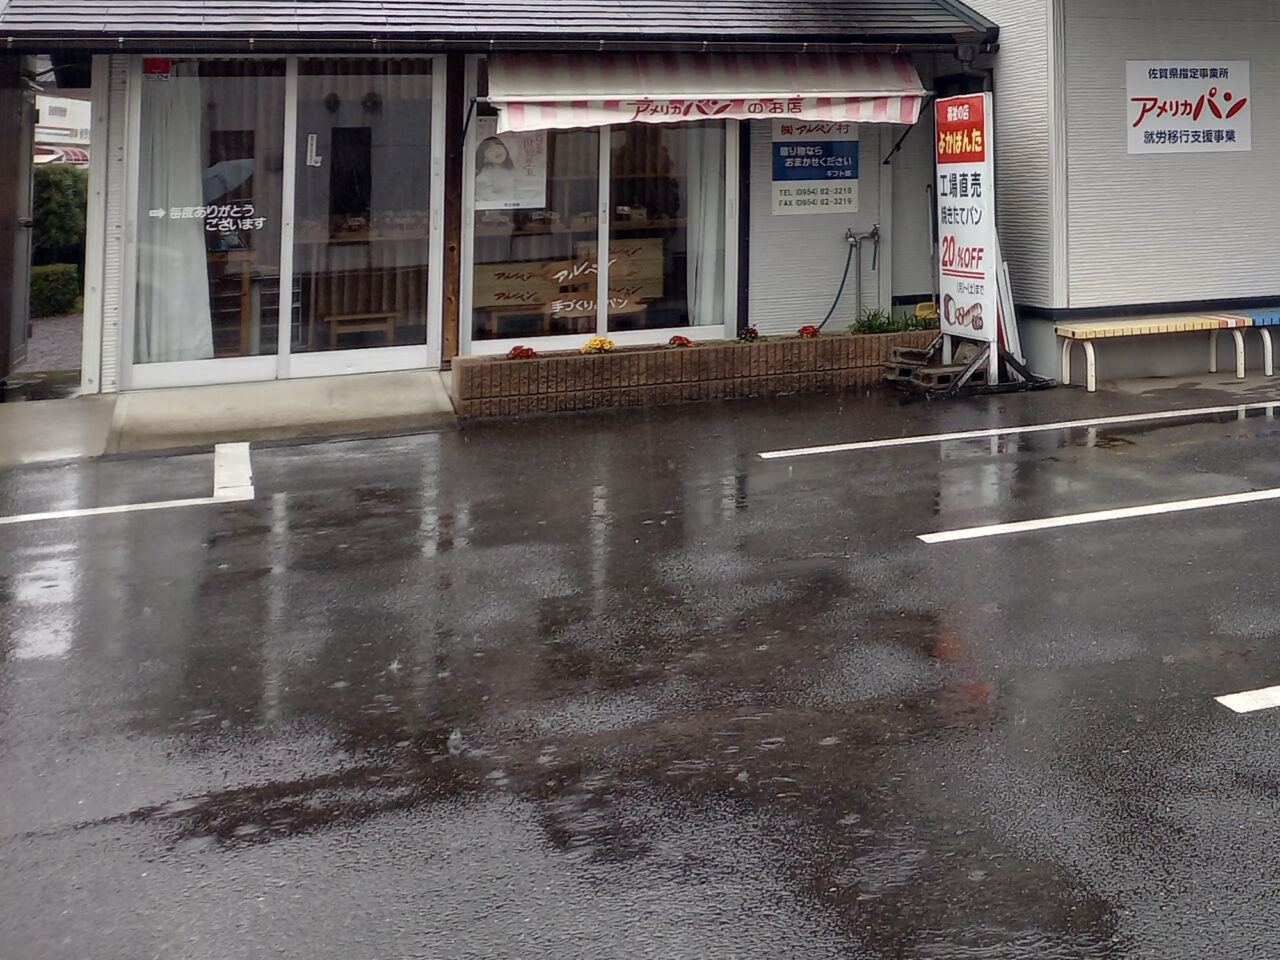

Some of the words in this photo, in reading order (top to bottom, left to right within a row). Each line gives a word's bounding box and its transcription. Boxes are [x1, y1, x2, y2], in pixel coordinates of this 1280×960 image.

[1148, 67, 1229, 80] 佐賀県指定事業所
[1130, 87, 1248, 128] アメリカパン
[1143, 129, 1236, 144] 就労移行支援事業
[784, 157, 852, 167] おまかせください
[940, 172, 982, 198] 工場直売
[778, 199, 793, 207] FAX
[169, 204, 254, 218] 毎度ありがとう
[205, 217, 266, 231] ございます
